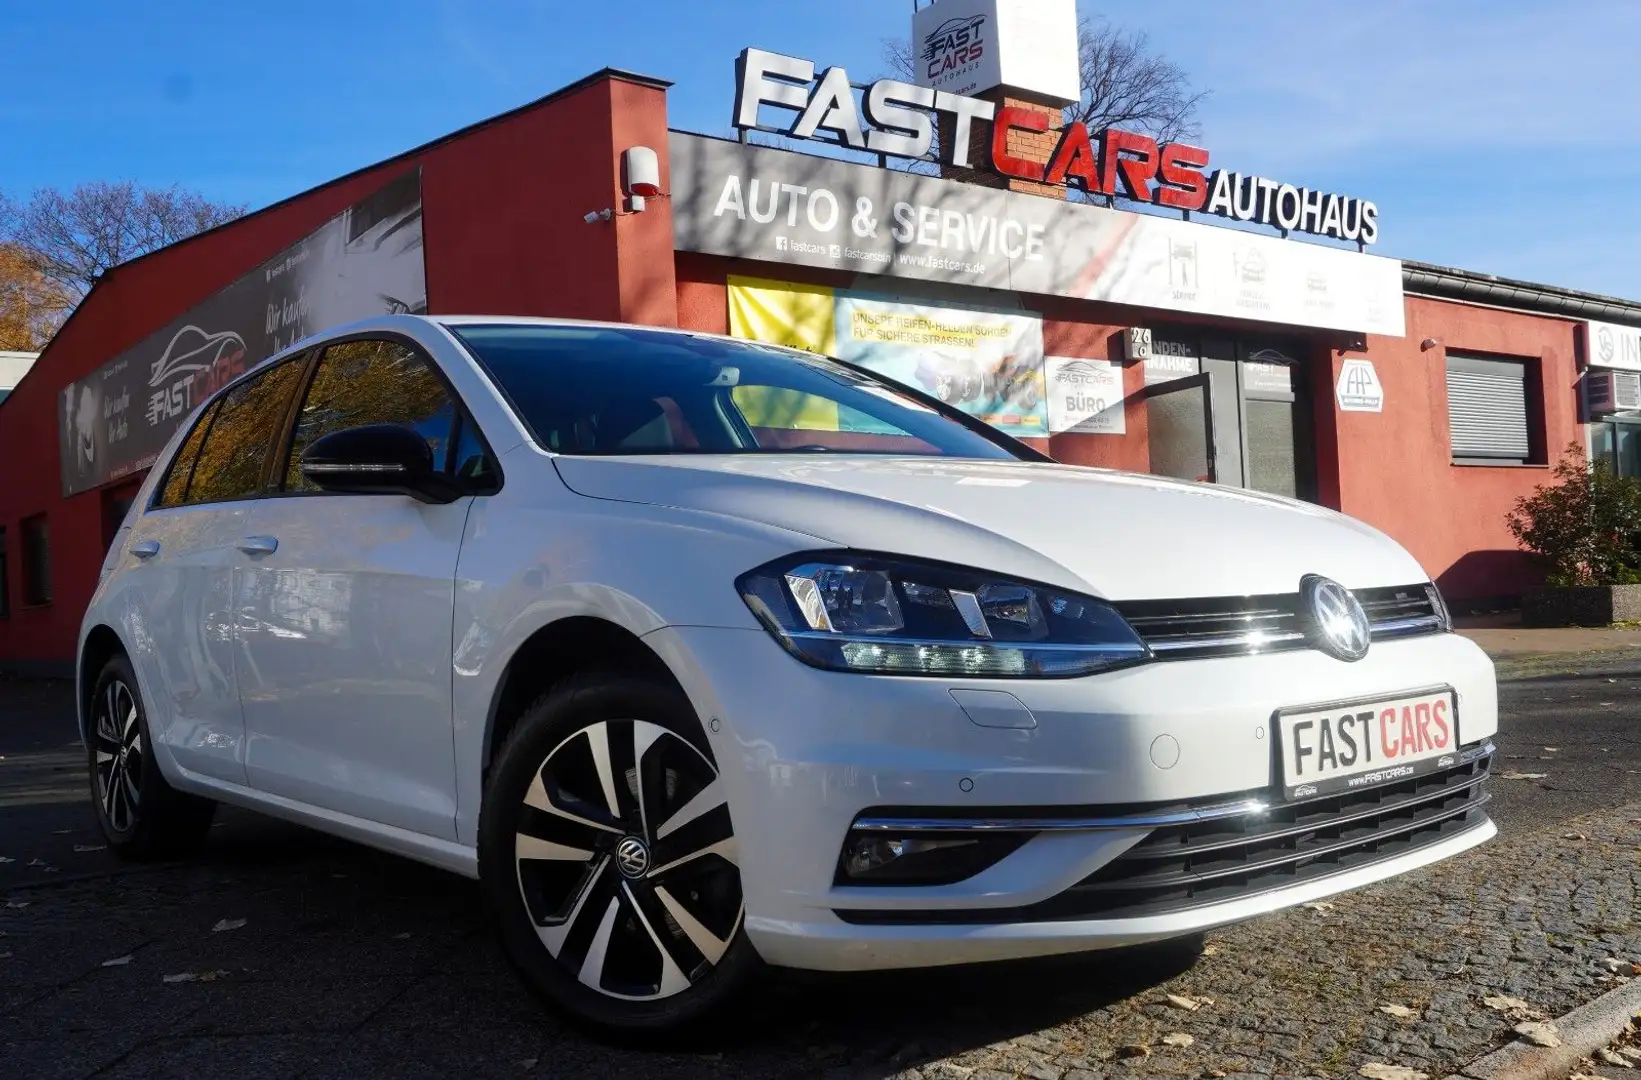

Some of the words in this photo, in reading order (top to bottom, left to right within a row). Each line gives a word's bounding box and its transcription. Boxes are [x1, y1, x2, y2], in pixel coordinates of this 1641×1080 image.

[927, 19, 984, 60] FAST
[927, 40, 983, 79] CARS
[932, 62, 980, 87] AUTOHAUS
[713, 175, 840, 232] AUTO
[851, 196, 878, 239] &
[892, 201, 1045, 261] SERVICE
[1209, 169, 1379, 245] AUTOHAUS
[790, 238, 826, 255] fastcars
[900, 254, 986, 275] www.fastcars.de
[1131, 327, 1149, 345] 26
[1065, 391, 1106, 412] BÜRO
